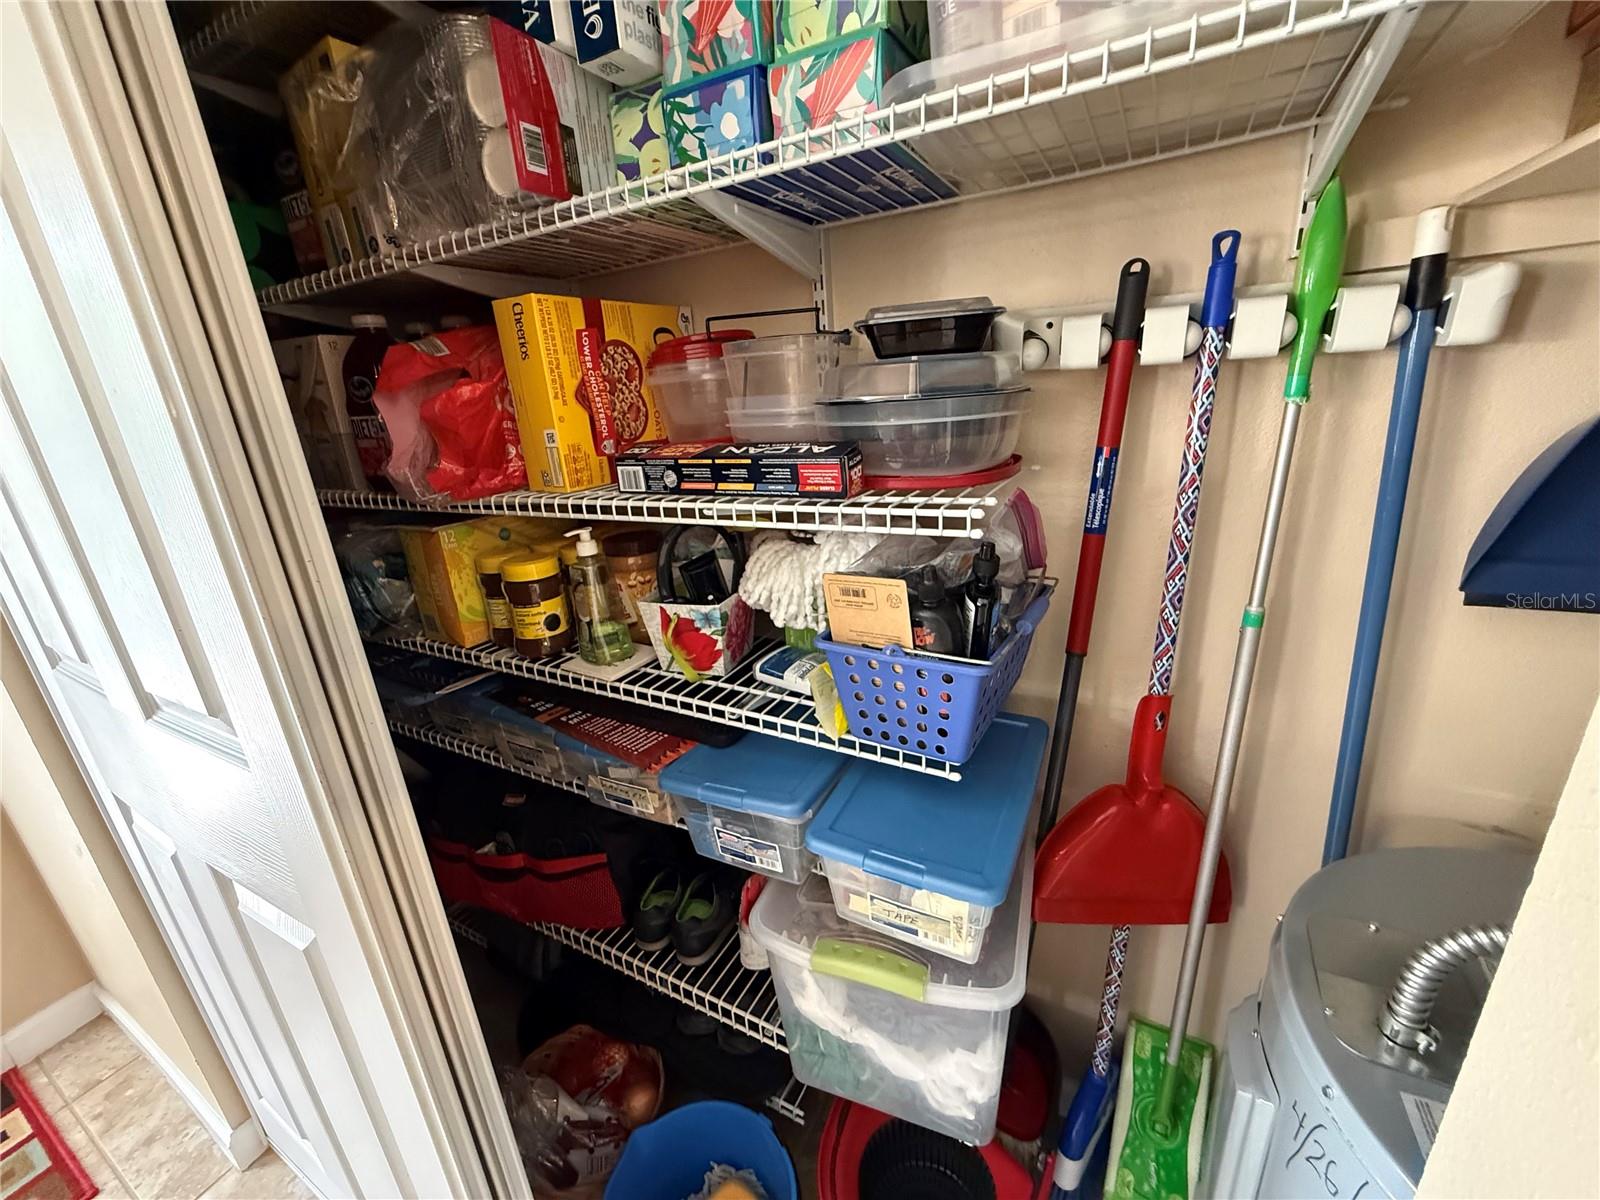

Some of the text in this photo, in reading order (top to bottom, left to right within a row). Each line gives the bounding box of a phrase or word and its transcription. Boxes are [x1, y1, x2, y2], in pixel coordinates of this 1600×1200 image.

[511, 302, 530, 361] Cheerios
[580, 331, 609, 439] LOWER CHOLESTEROL
[594, 370, 612, 417] CAN HELP
[720, 444, 837, 455] ALCAN
[442, 530, 457, 543] 12
[883, 907, 920, 925] TAPE
